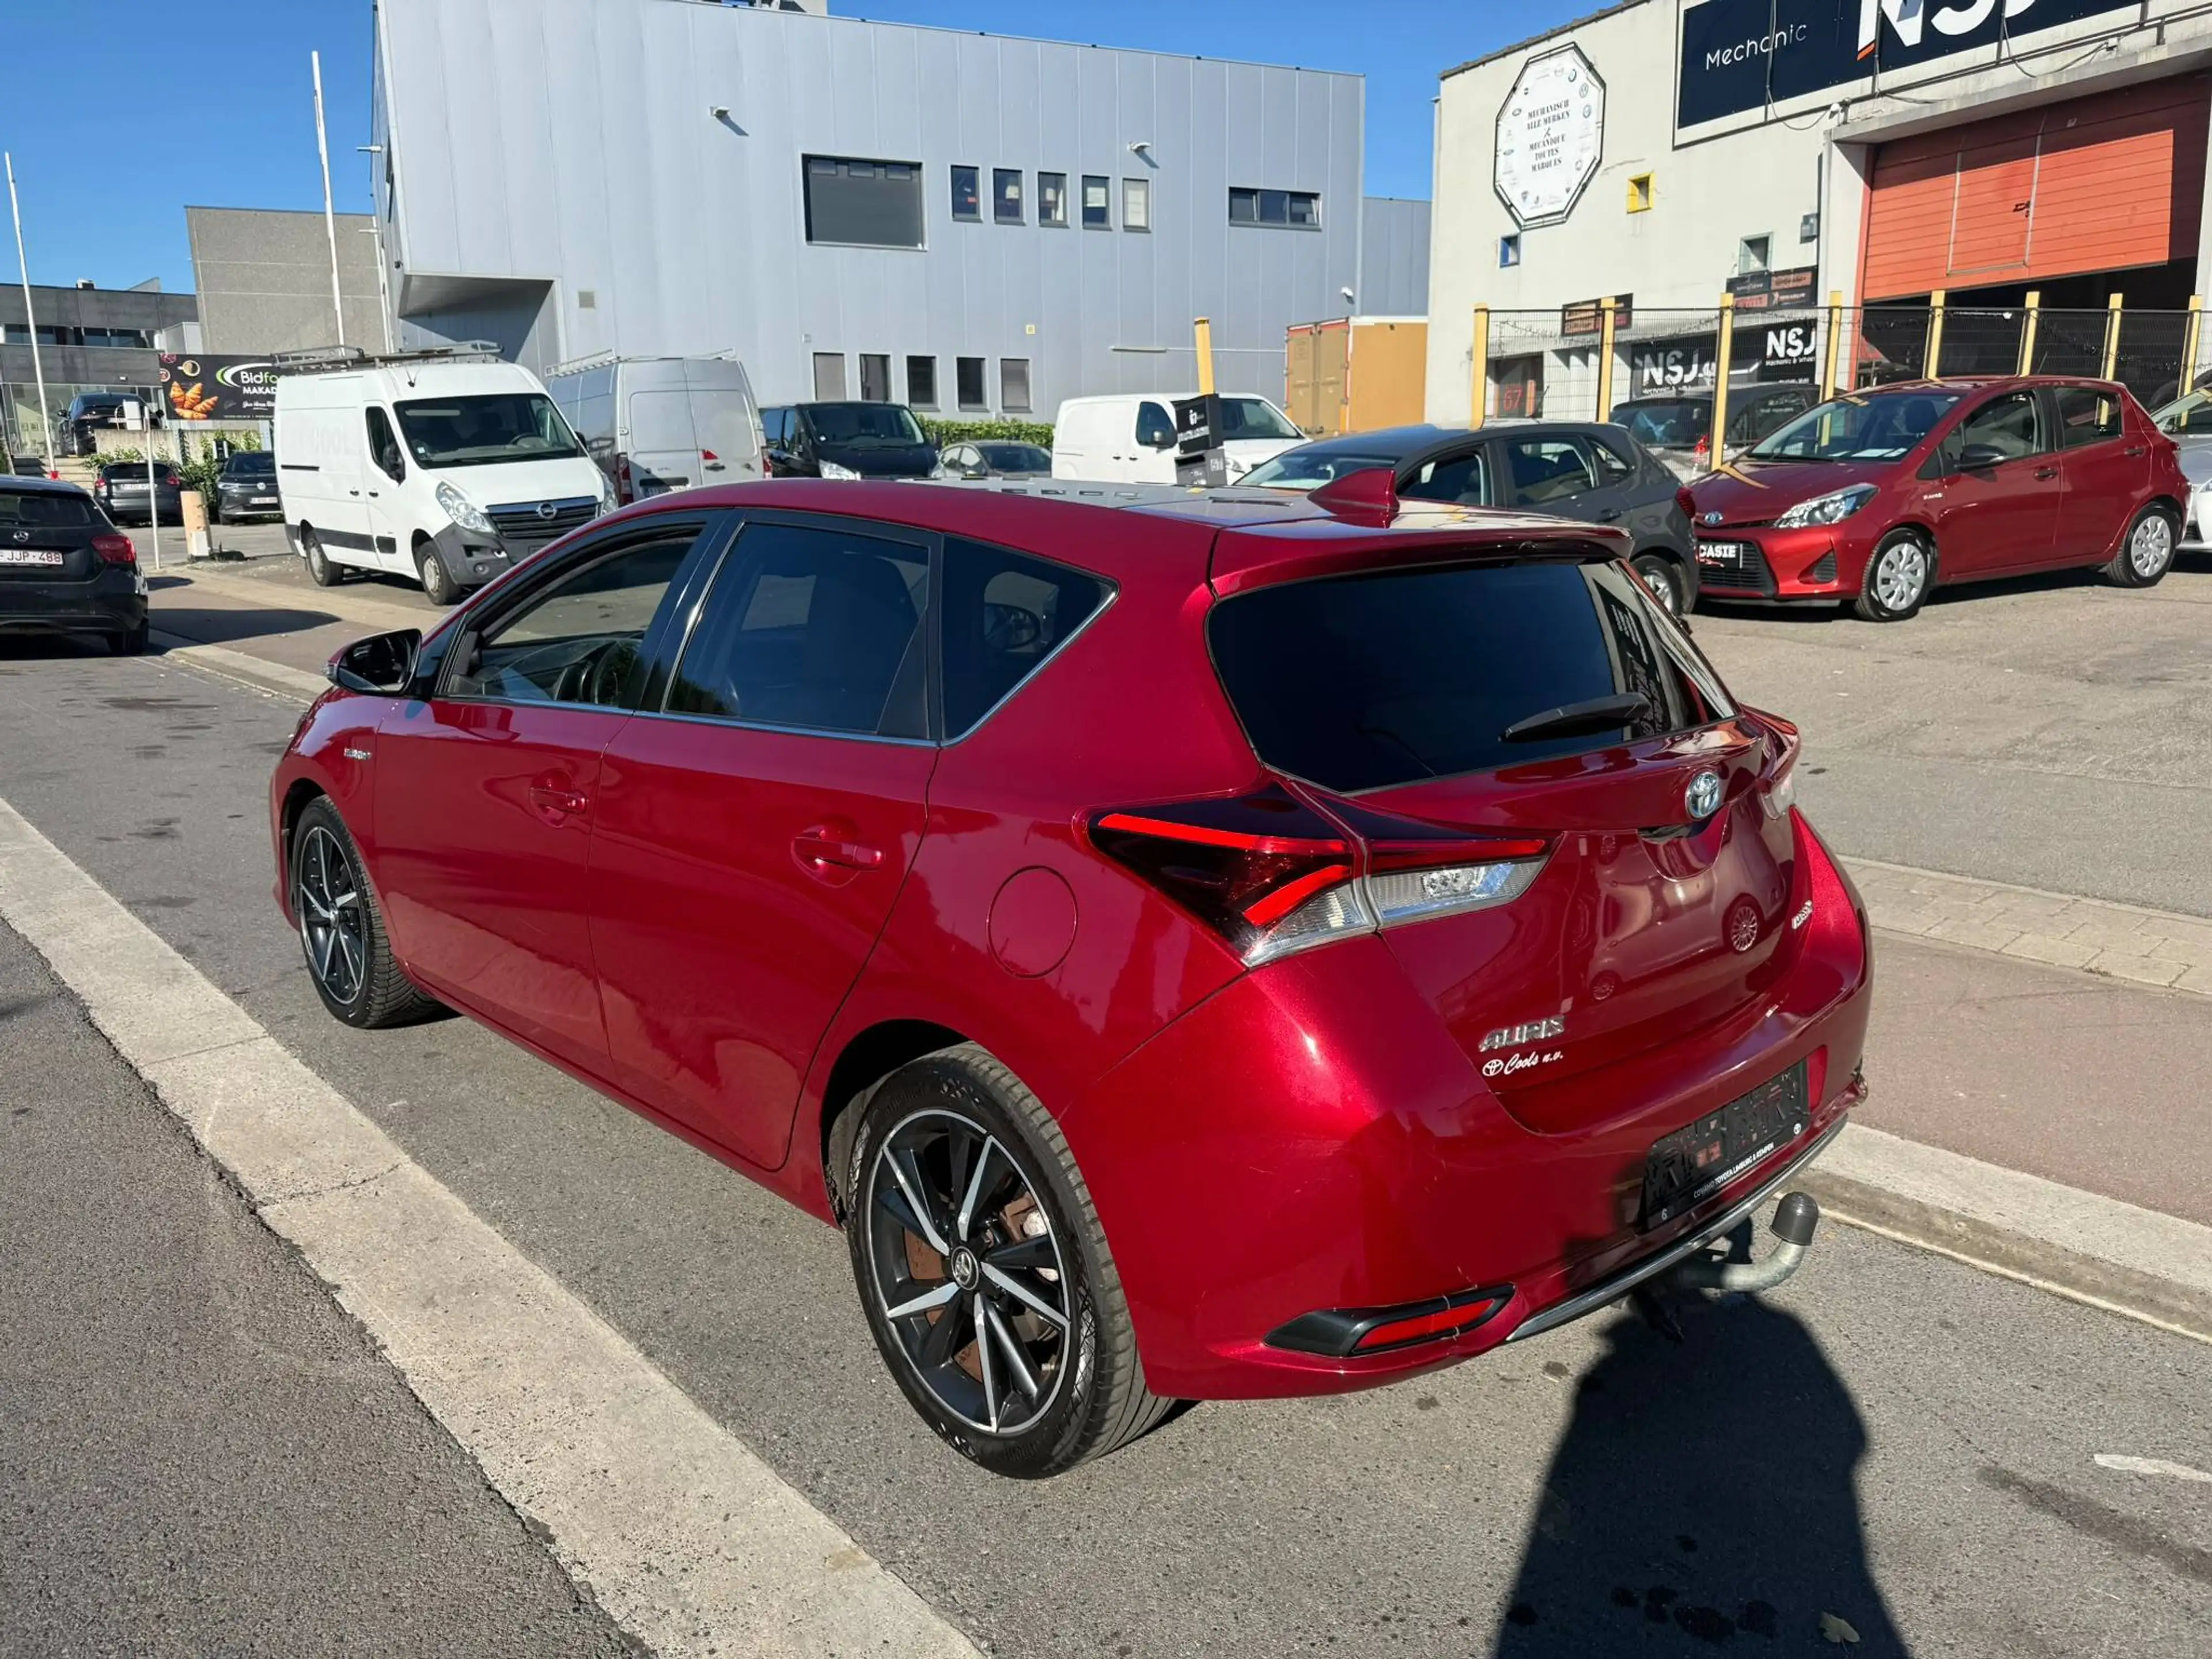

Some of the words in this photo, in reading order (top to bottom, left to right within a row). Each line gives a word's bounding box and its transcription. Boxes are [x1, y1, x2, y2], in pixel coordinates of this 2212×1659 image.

[1706, 24, 1807, 71] Mechanic
[1766, 327, 1816, 358] NSJ
[1642, 348, 1699, 387] NSJ
[1478, 1014, 1565, 1053] AURIS
[1504, 1051, 1539, 1075] Cools
[1714, 1168, 1733, 1185] TOYOTA
[1733, 1155, 1753, 1175] LIMBURG
[1756, 1142, 1775, 1158] KEMPEN
